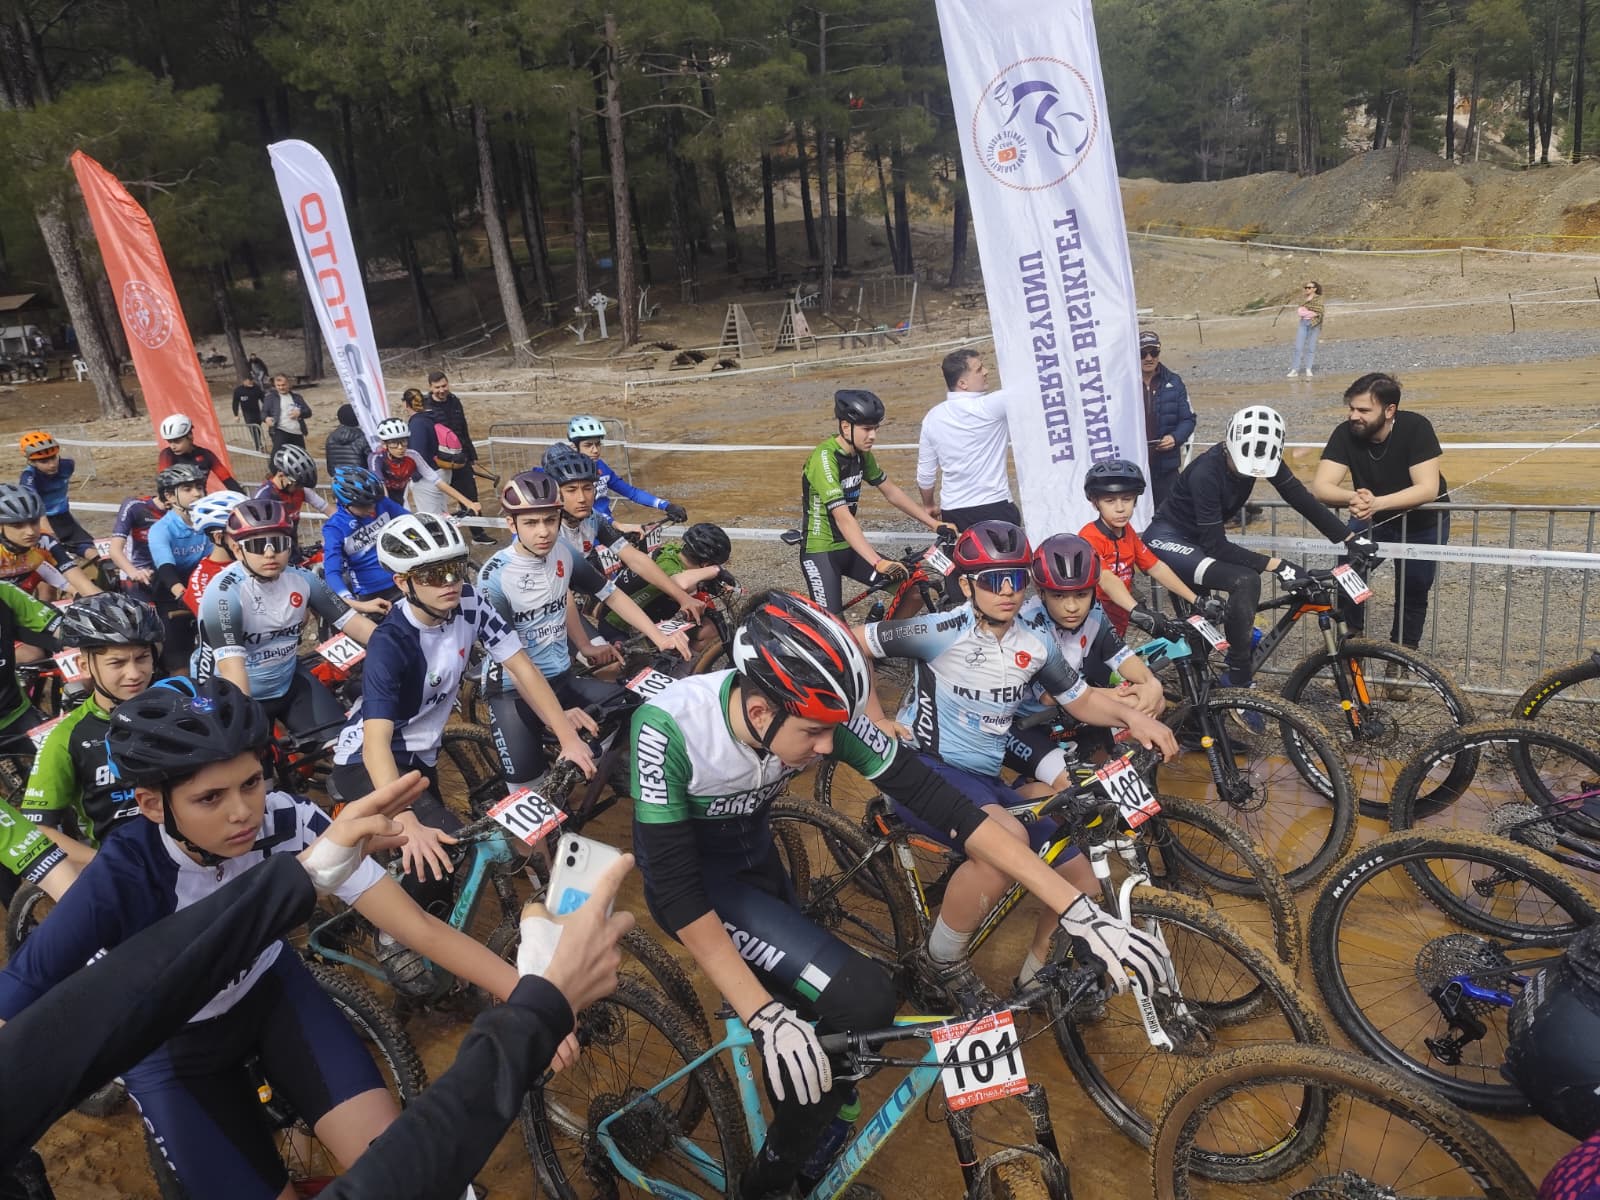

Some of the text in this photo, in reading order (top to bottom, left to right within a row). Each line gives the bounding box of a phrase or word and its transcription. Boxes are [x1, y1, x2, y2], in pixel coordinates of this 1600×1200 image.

[242, 631, 263, 646] KI
[895, 624, 929, 638] TEKER
[327, 639, 358, 664] 121
[640, 673, 673, 695] 103
[990, 683, 1029, 703] TEK
[492, 727, 515, 776] TEKER
[1110, 770, 1152, 812] 102
[504, 795, 555, 833] 108
[17, 838, 55, 869] carra
[26, 848, 66, 883] SHIMAN
[944, 1031, 1018, 1089] 101
